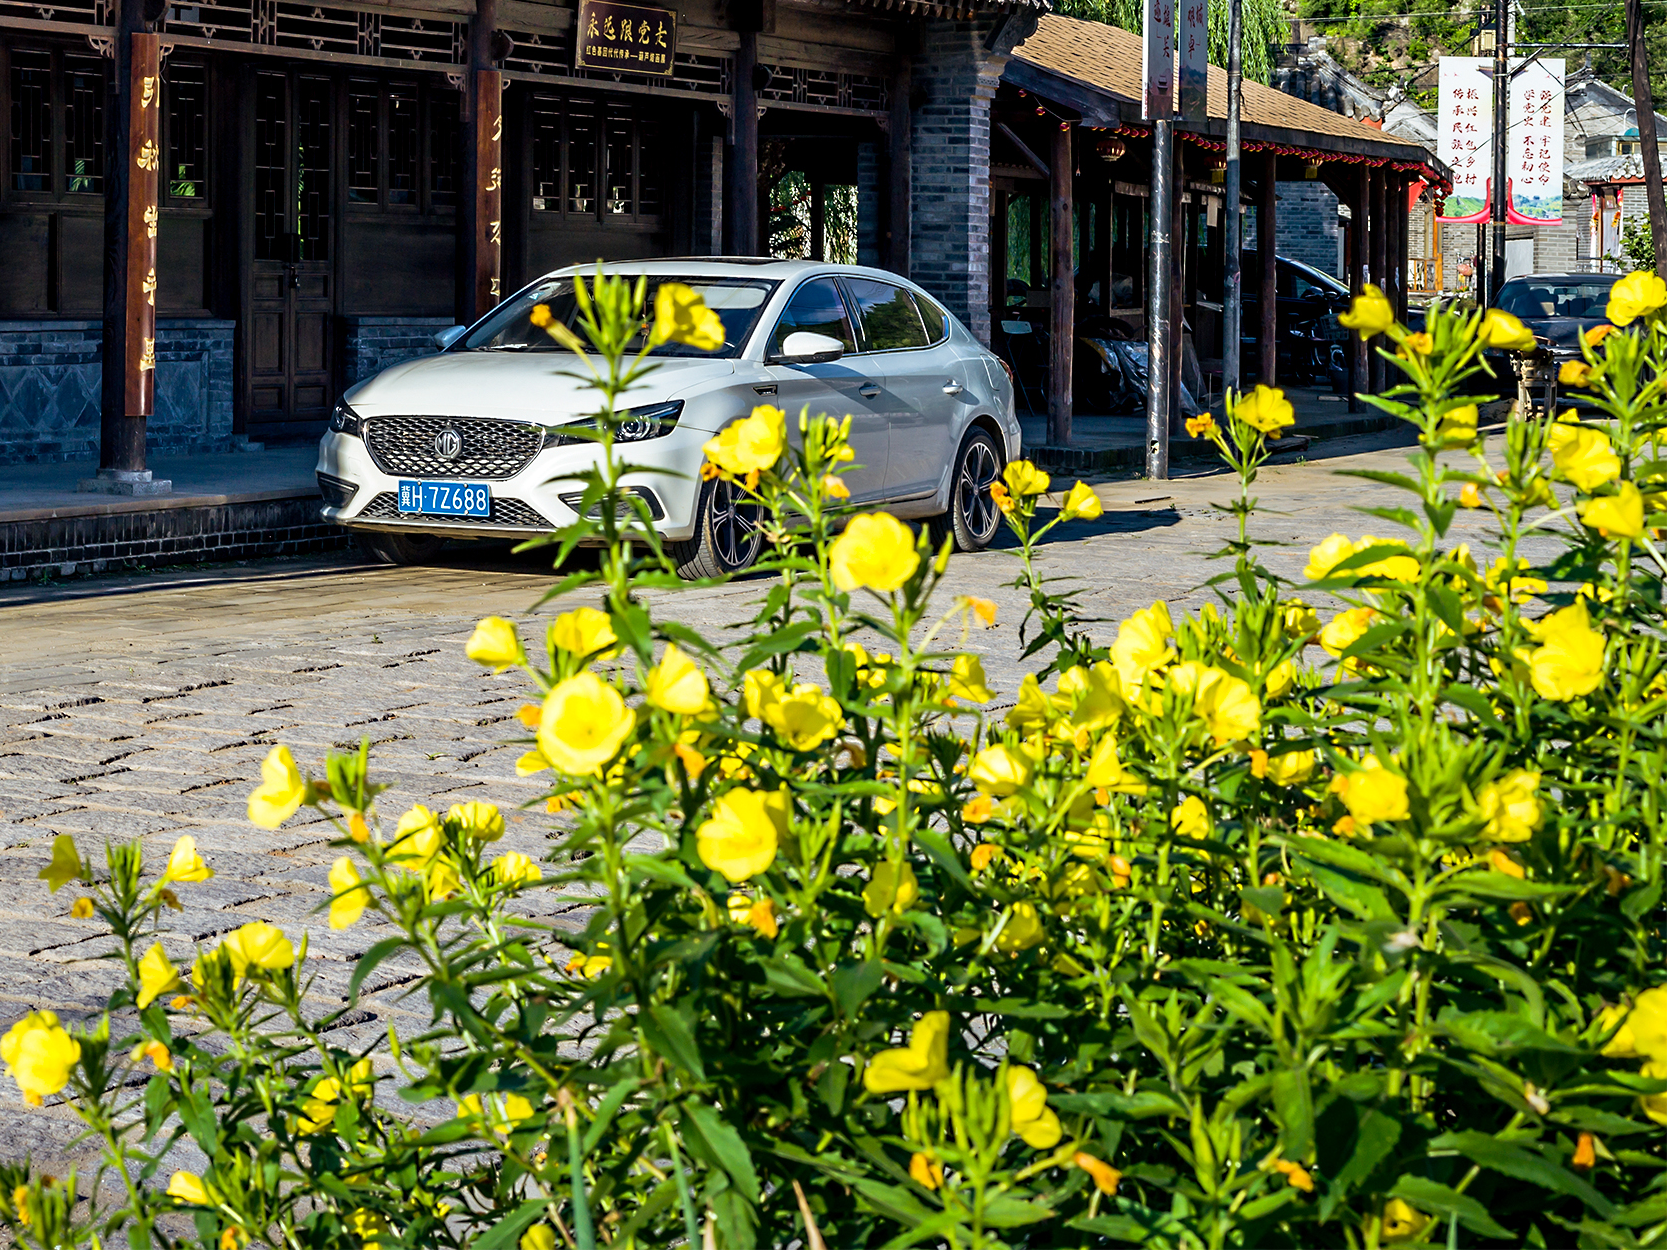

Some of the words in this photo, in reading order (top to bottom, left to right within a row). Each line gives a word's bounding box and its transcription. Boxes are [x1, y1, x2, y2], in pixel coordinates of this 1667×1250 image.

[586, 11, 668, 49] 永远跟党走
[1465, 88, 1479, 186] 振兴红色乡村
[436, 430, 461, 457] MG
